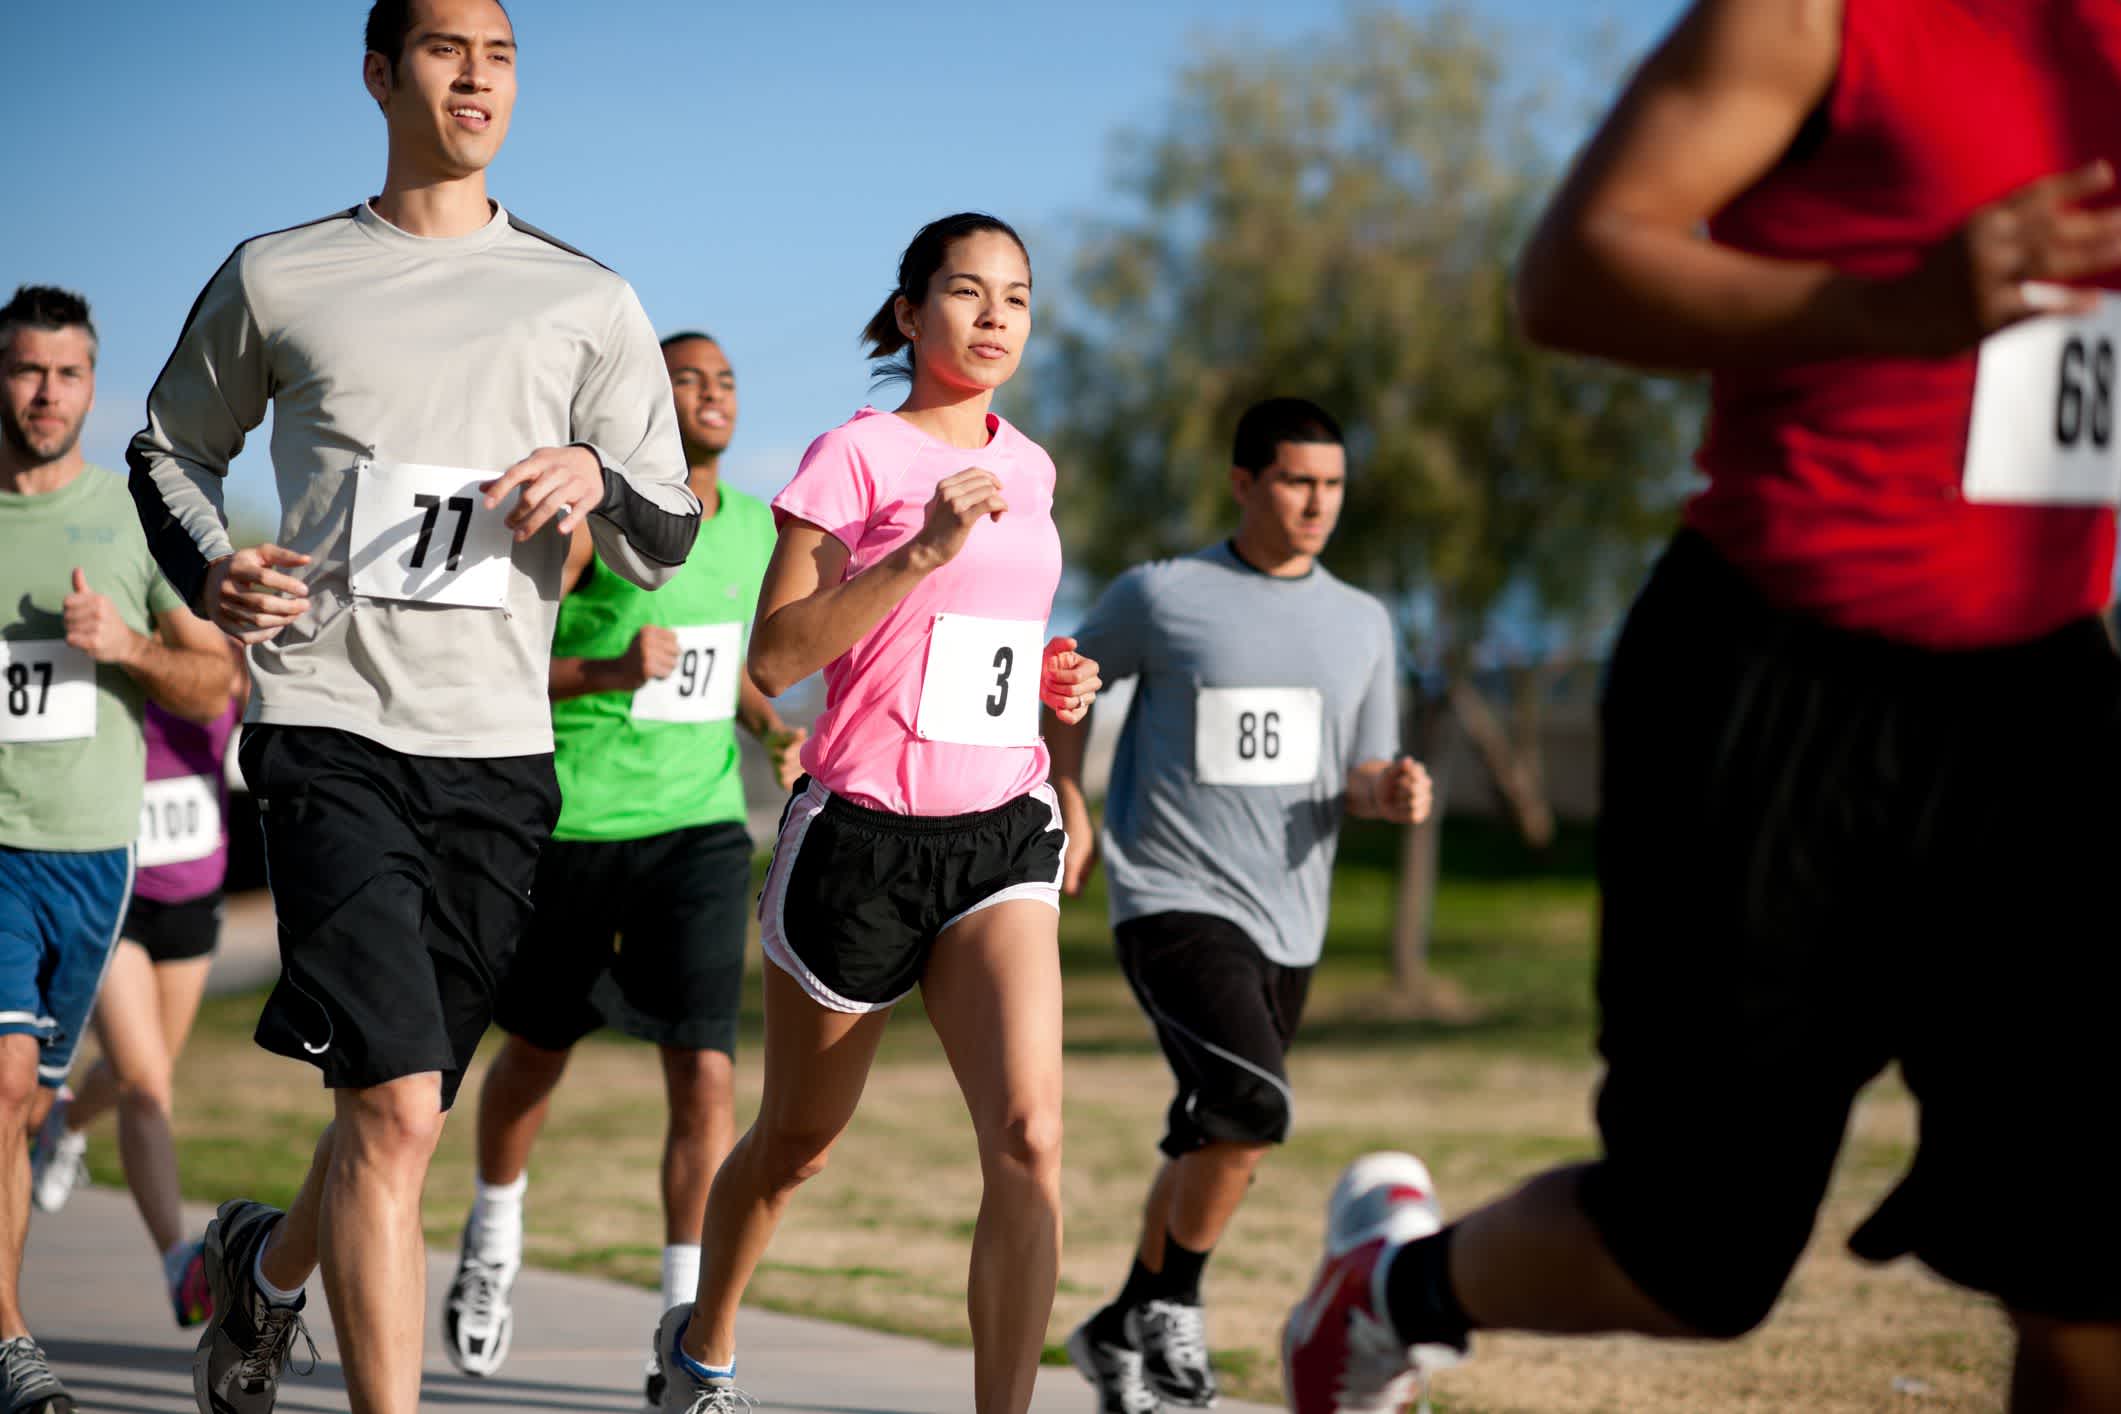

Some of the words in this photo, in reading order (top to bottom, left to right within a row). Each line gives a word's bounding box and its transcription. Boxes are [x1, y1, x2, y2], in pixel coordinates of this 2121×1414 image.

[2055, 336, 2115, 451] 68
[410, 494, 474, 572] 77
[5, 661, 54, 717] 87
[680, 648, 715, 697] 97
[986, 646, 1013, 717] 3
[1238, 711, 1279, 760] 86
